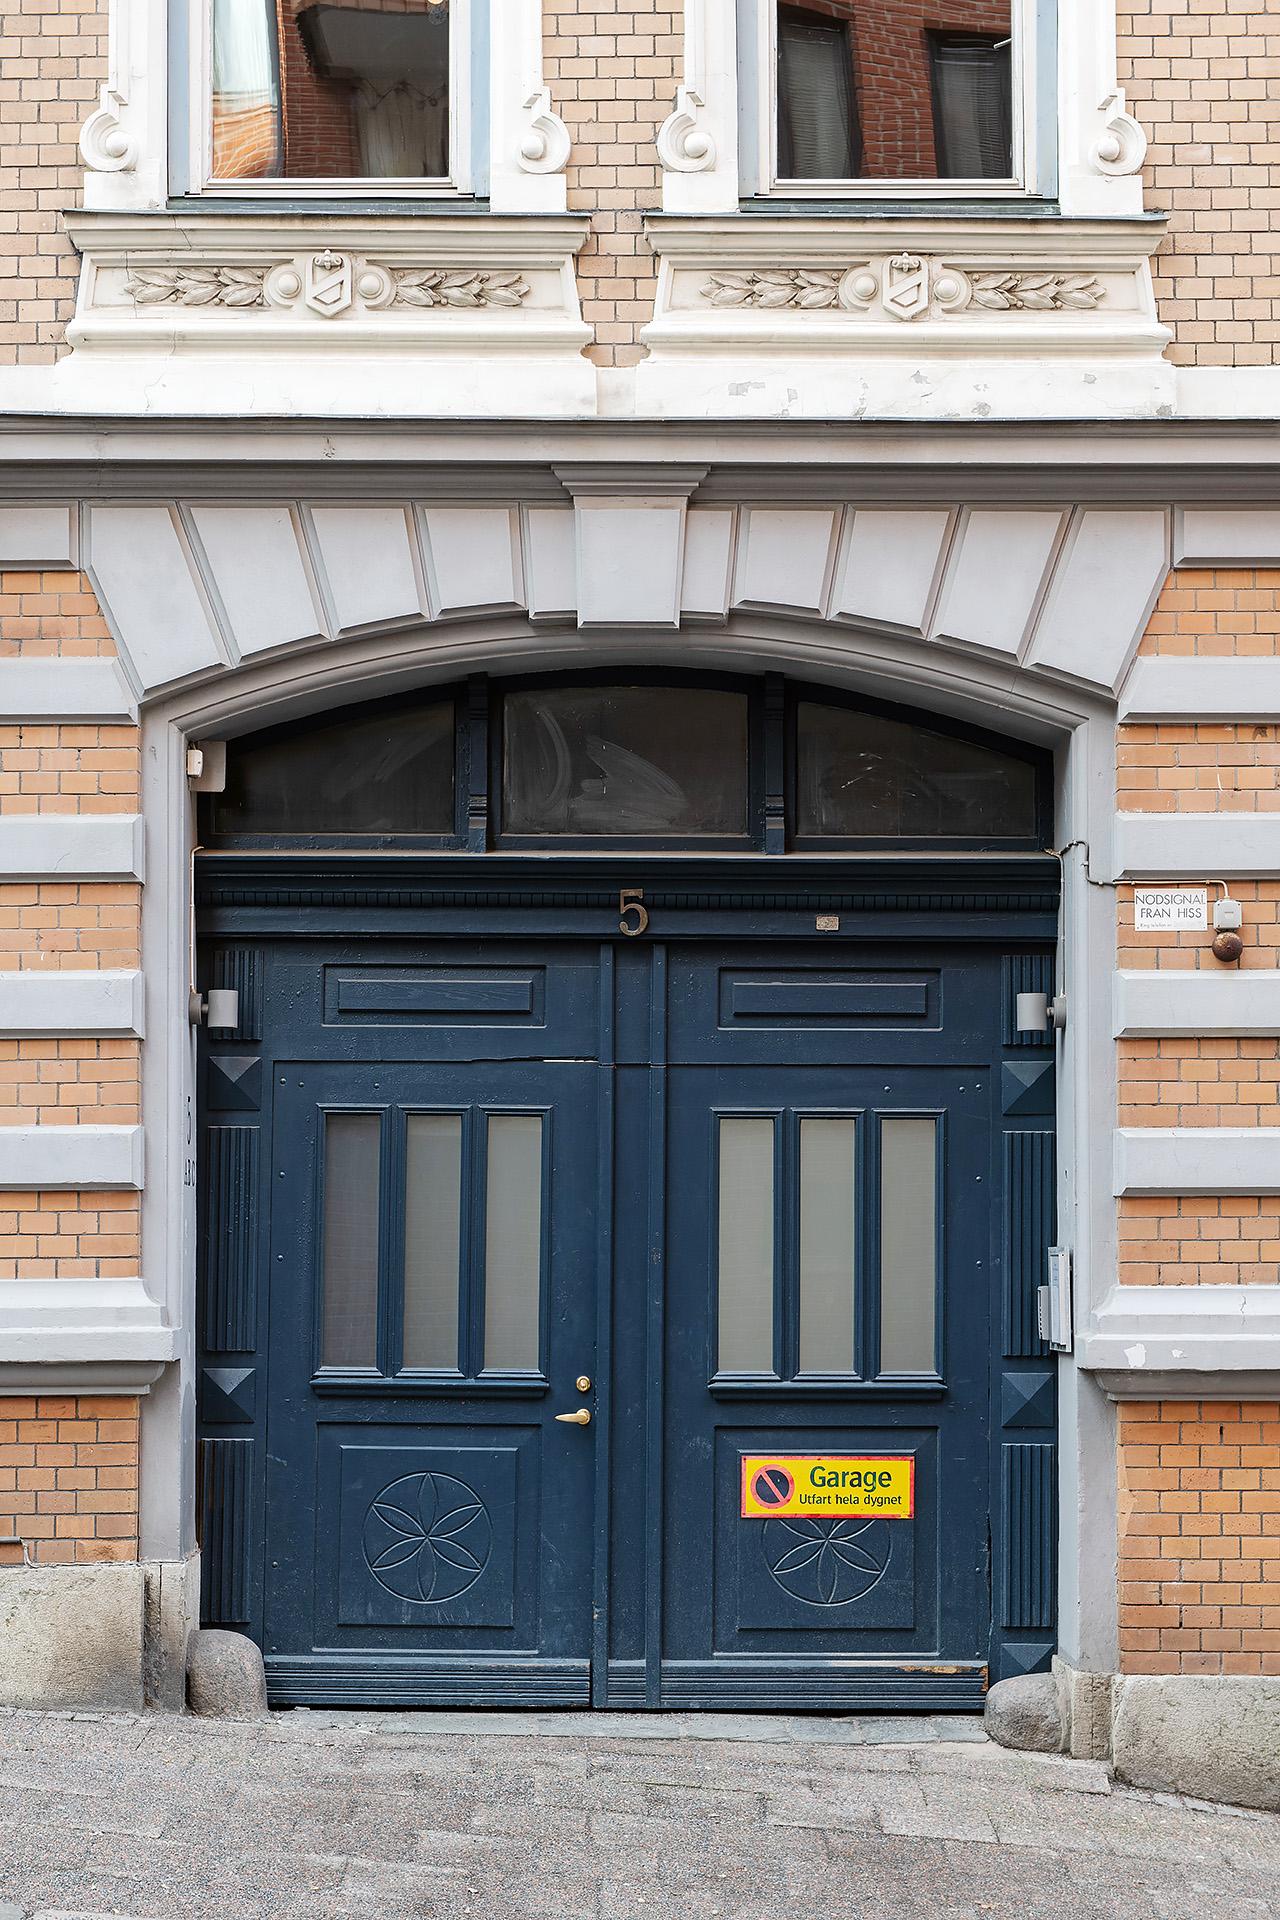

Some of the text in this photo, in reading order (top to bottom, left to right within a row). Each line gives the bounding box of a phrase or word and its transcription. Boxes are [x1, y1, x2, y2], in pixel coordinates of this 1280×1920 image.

[620, 889, 649, 936] 5
[1177, 907, 1202, 918] HISS
[810, 1465, 892, 1492] Garage
[799, 1493, 902, 1507] Utfart hela dygnet
